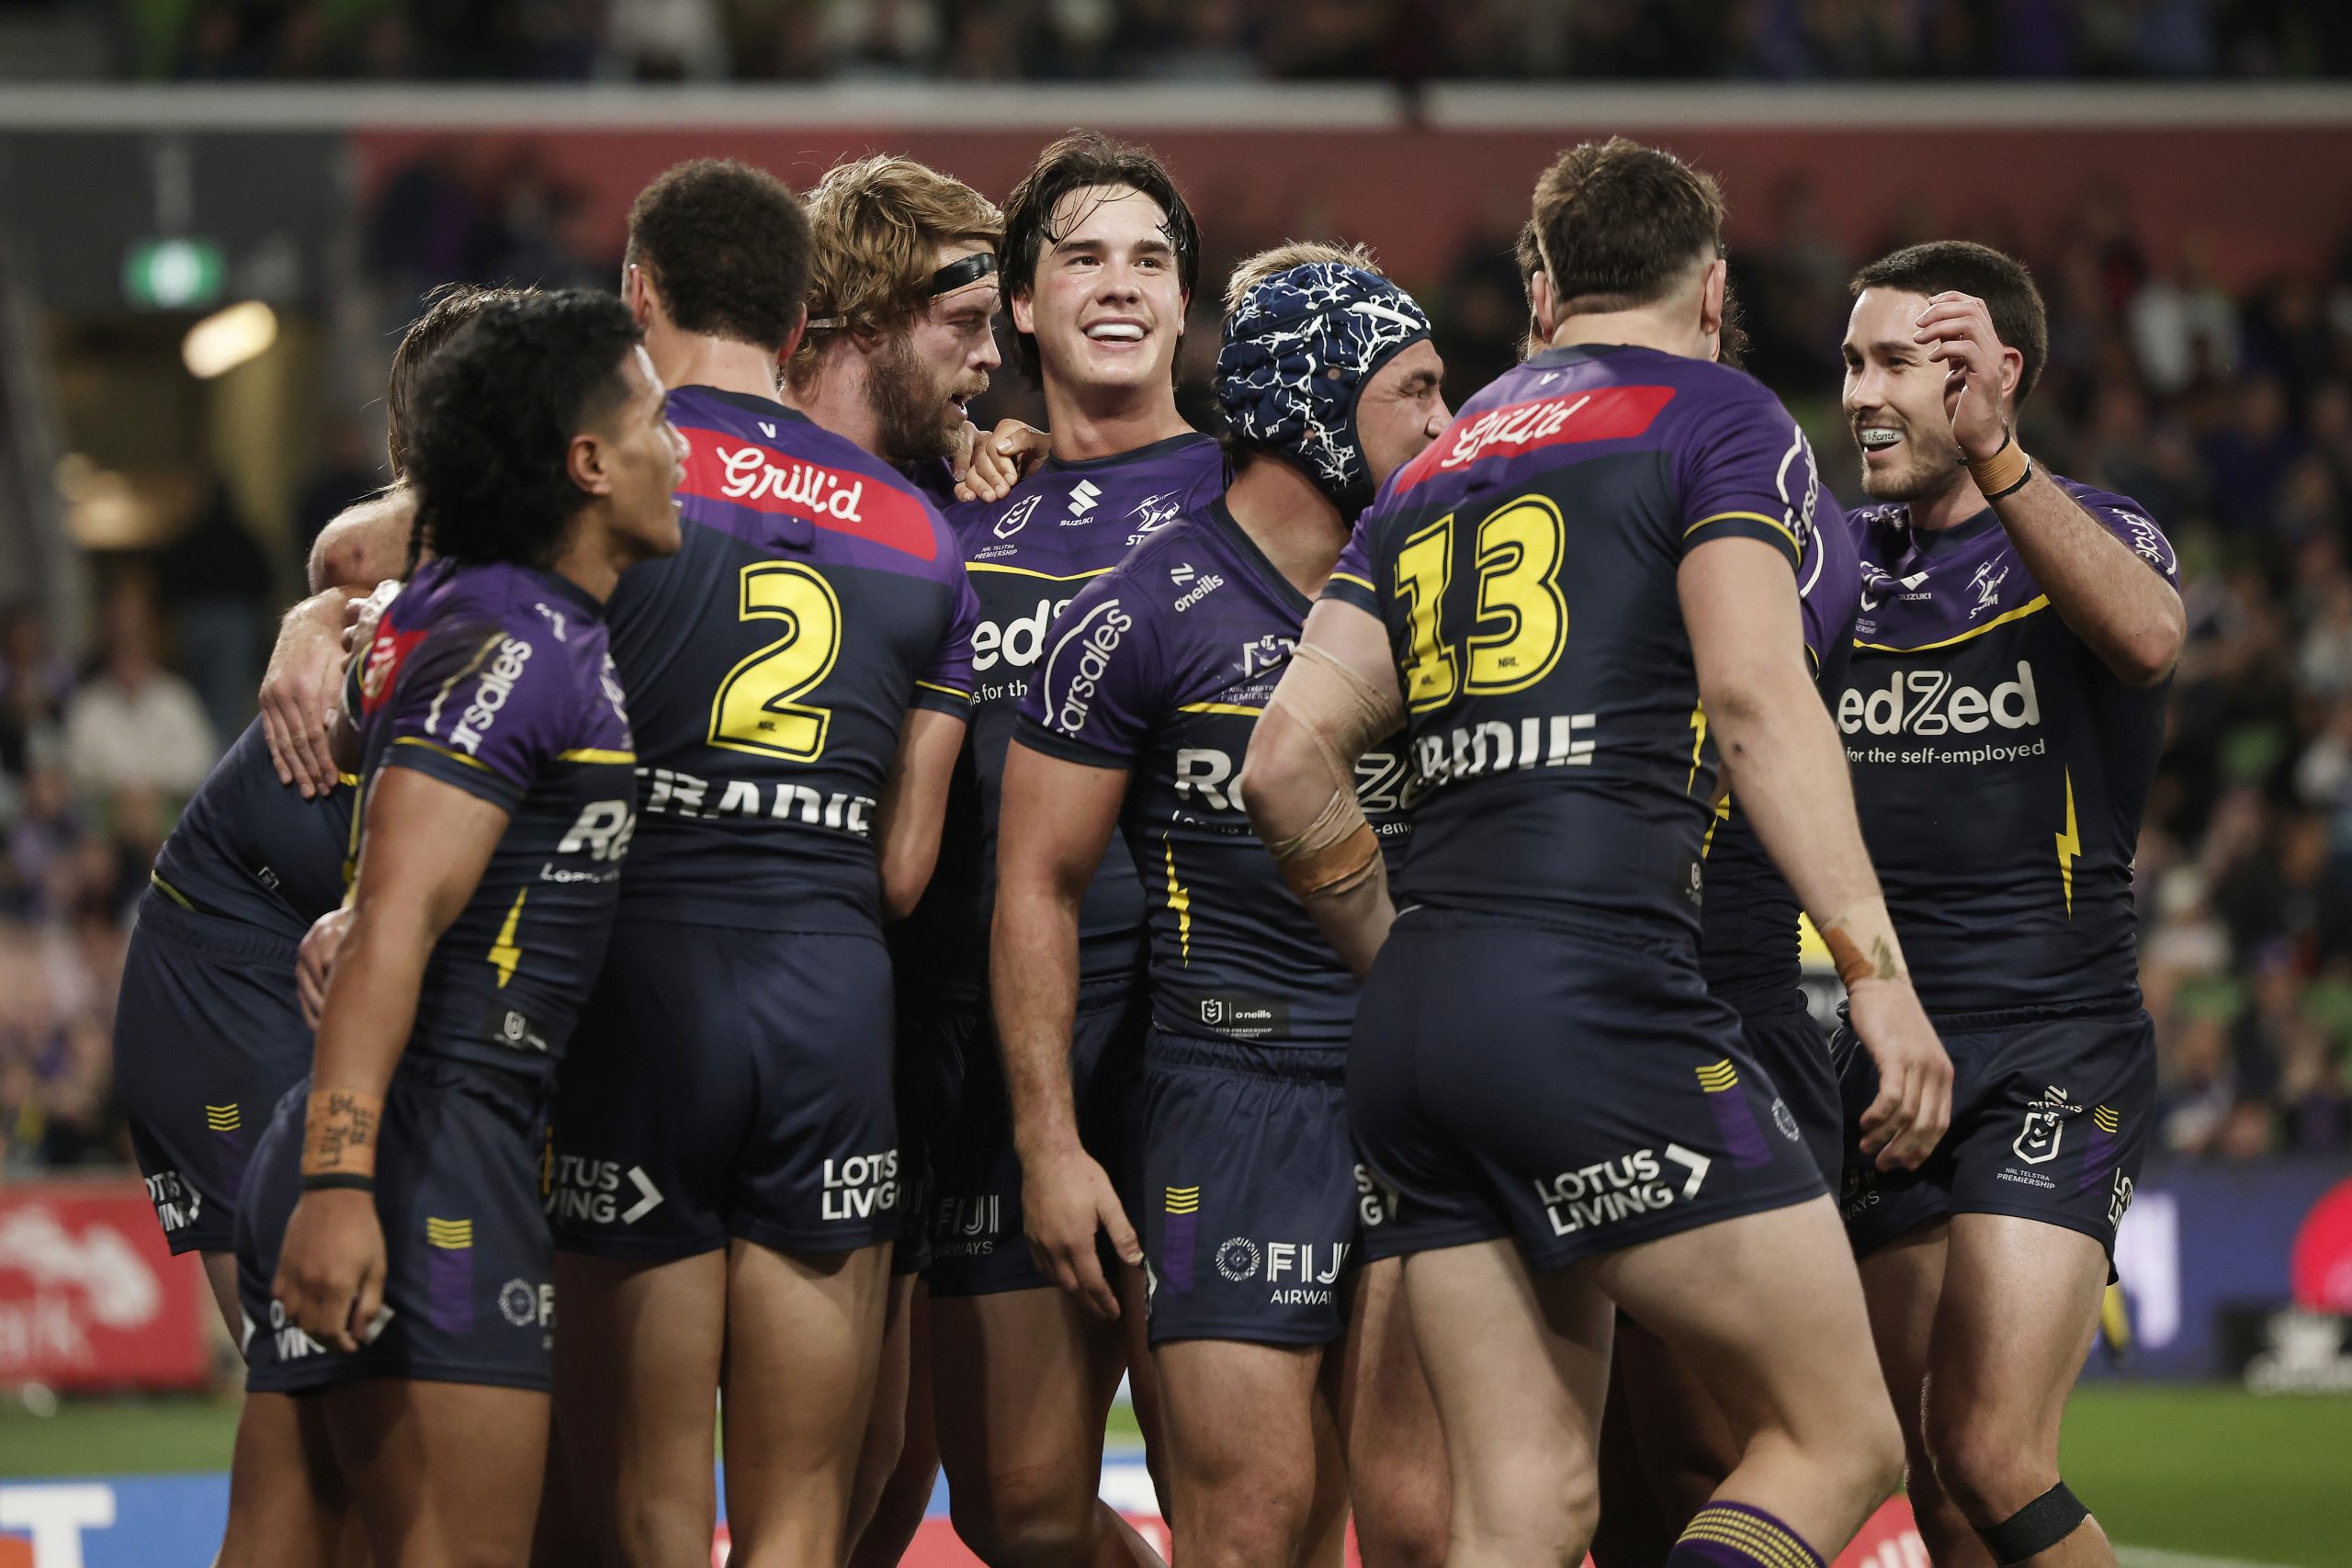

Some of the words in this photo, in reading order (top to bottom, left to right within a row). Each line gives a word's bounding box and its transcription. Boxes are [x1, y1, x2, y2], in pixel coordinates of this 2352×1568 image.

[716, 446, 862, 523] Grill'd
[1058, 515, 1095, 527] SUZUKI
[974, 548, 1018, 560] PREMIERSHIP
[1394, 493, 1569, 715] 13
[706, 559, 842, 764] 2
[1056, 608, 1133, 739] arsales
[982, 682, 1004, 701] for
[1868, 747, 1897, 763] the
[1900, 738, 2046, 765] self-employed
[1534, 1148, 1661, 1205] LOTUS
[1996, 1172, 2056, 1190] PREMIERSHIP
[2005, 1168, 2019, 1176] NRL
[2019, 1169, 2051, 1182] TELSTRA
[1546, 1180, 1673, 1237] LIVING
[1266, 1241, 1351, 1284] FIJ
